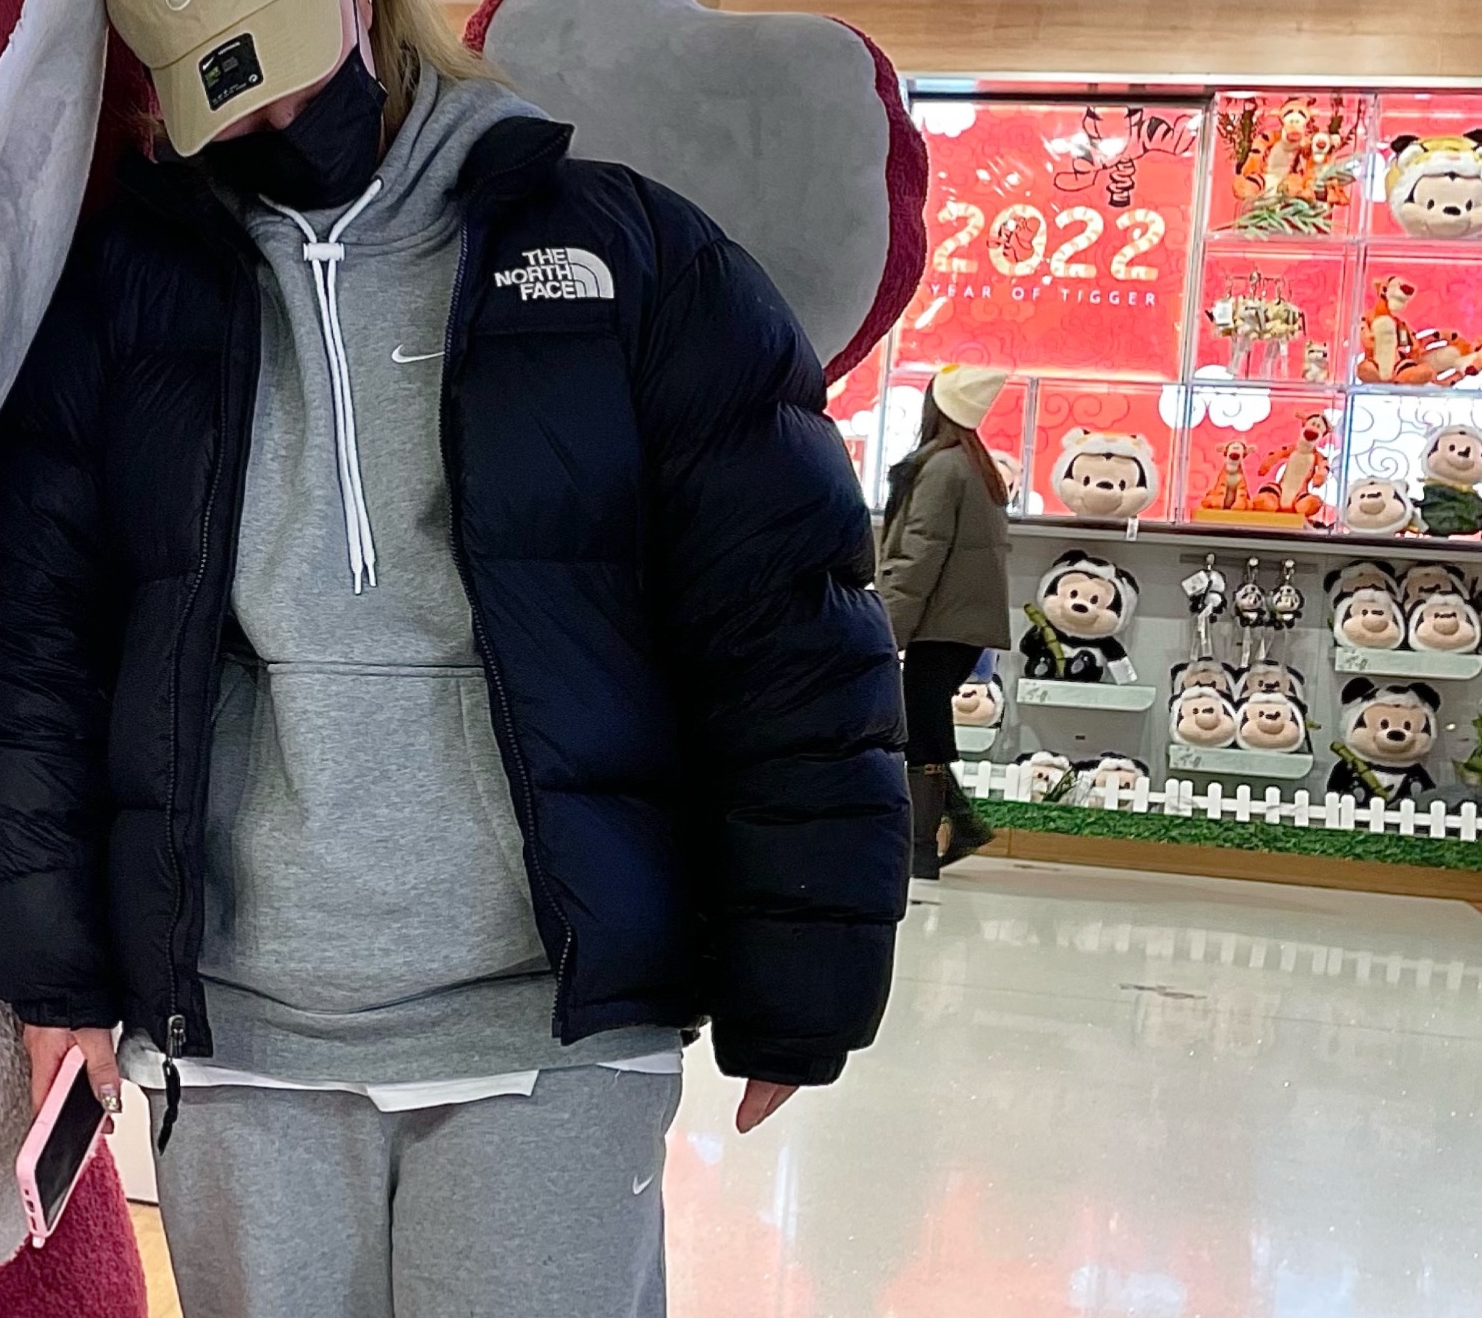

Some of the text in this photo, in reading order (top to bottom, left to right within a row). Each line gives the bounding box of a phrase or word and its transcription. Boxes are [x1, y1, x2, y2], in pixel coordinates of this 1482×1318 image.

[932, 201, 1166, 281] 2022
[521, 247, 568, 265] THE
[494, 264, 573, 287] NORTH
[520, 281, 577, 301] FACE
[930, 284, 1156, 306] YEAR OF TIGGER
